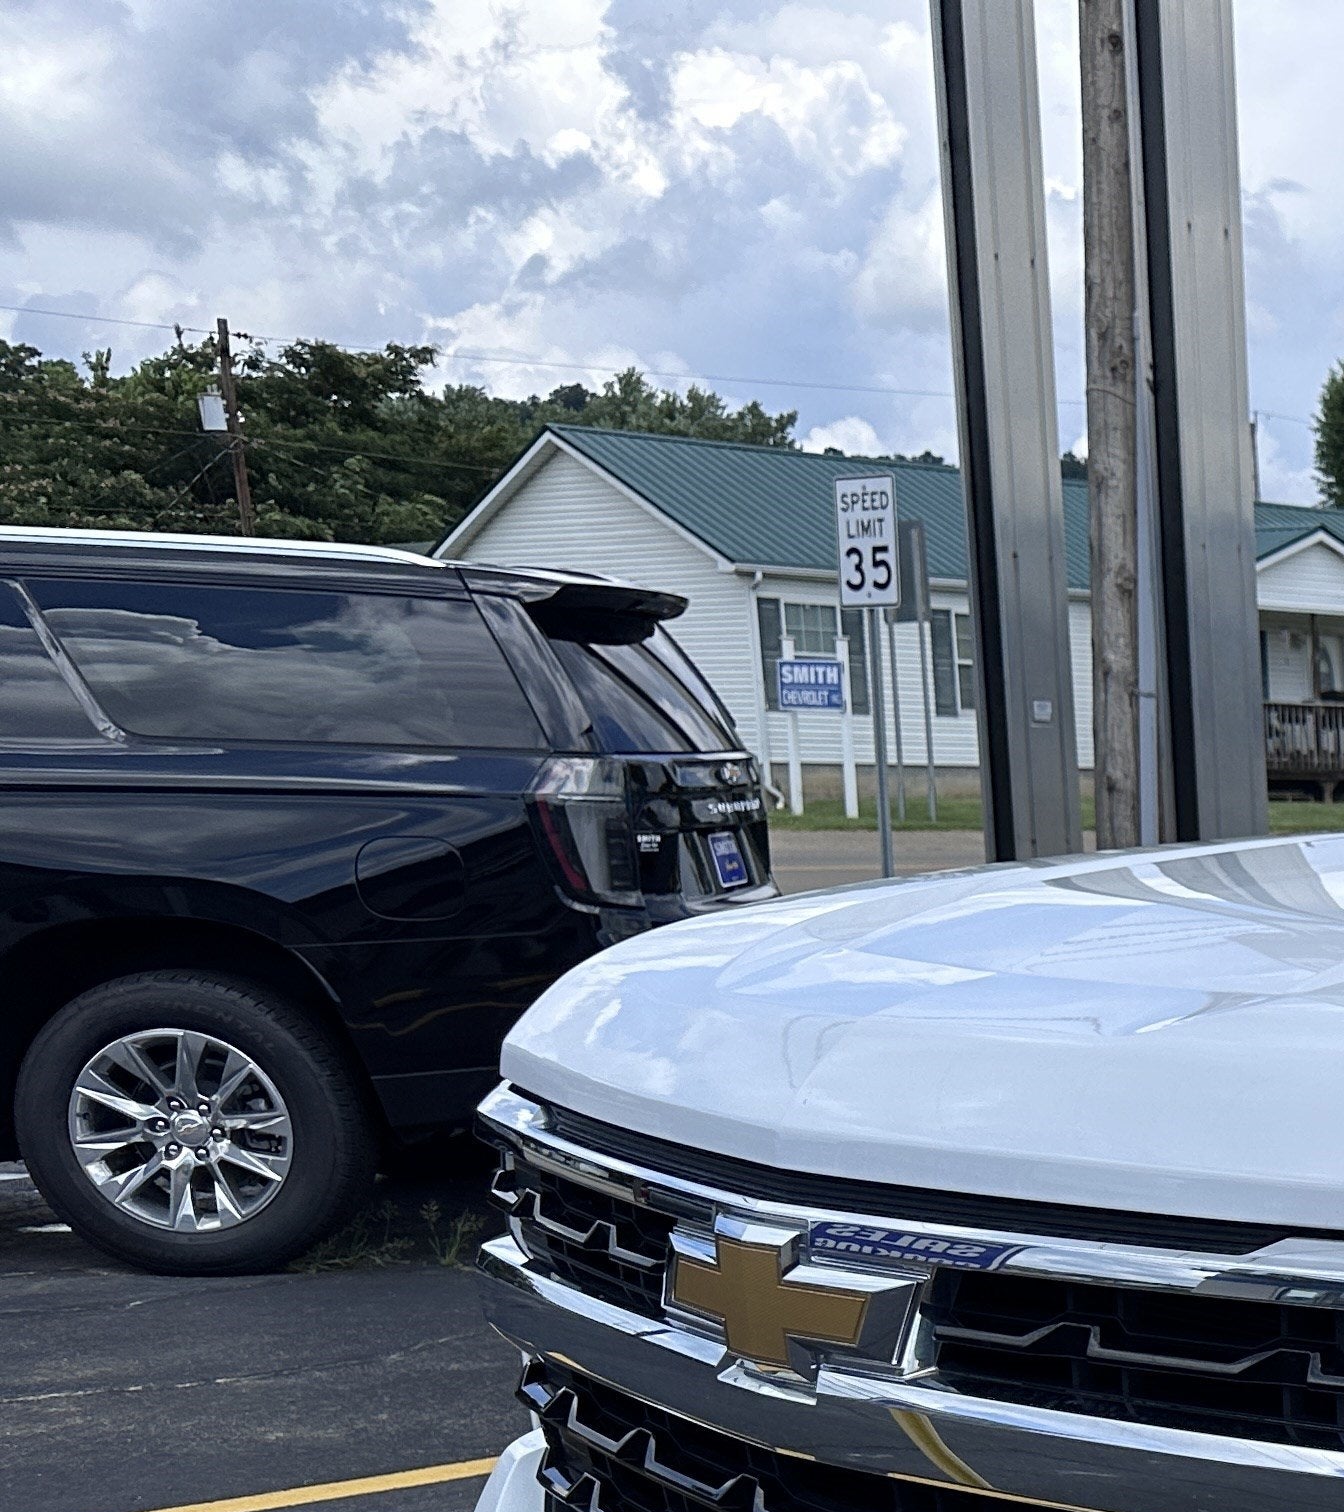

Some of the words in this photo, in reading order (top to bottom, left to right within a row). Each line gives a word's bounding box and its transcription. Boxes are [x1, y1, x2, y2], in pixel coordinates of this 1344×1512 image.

[840, 490, 890, 513] SPEED
[846, 518, 885, 539] LIMIT
[845, 545, 893, 592] 35
[781, 664, 839, 685] SMITH
